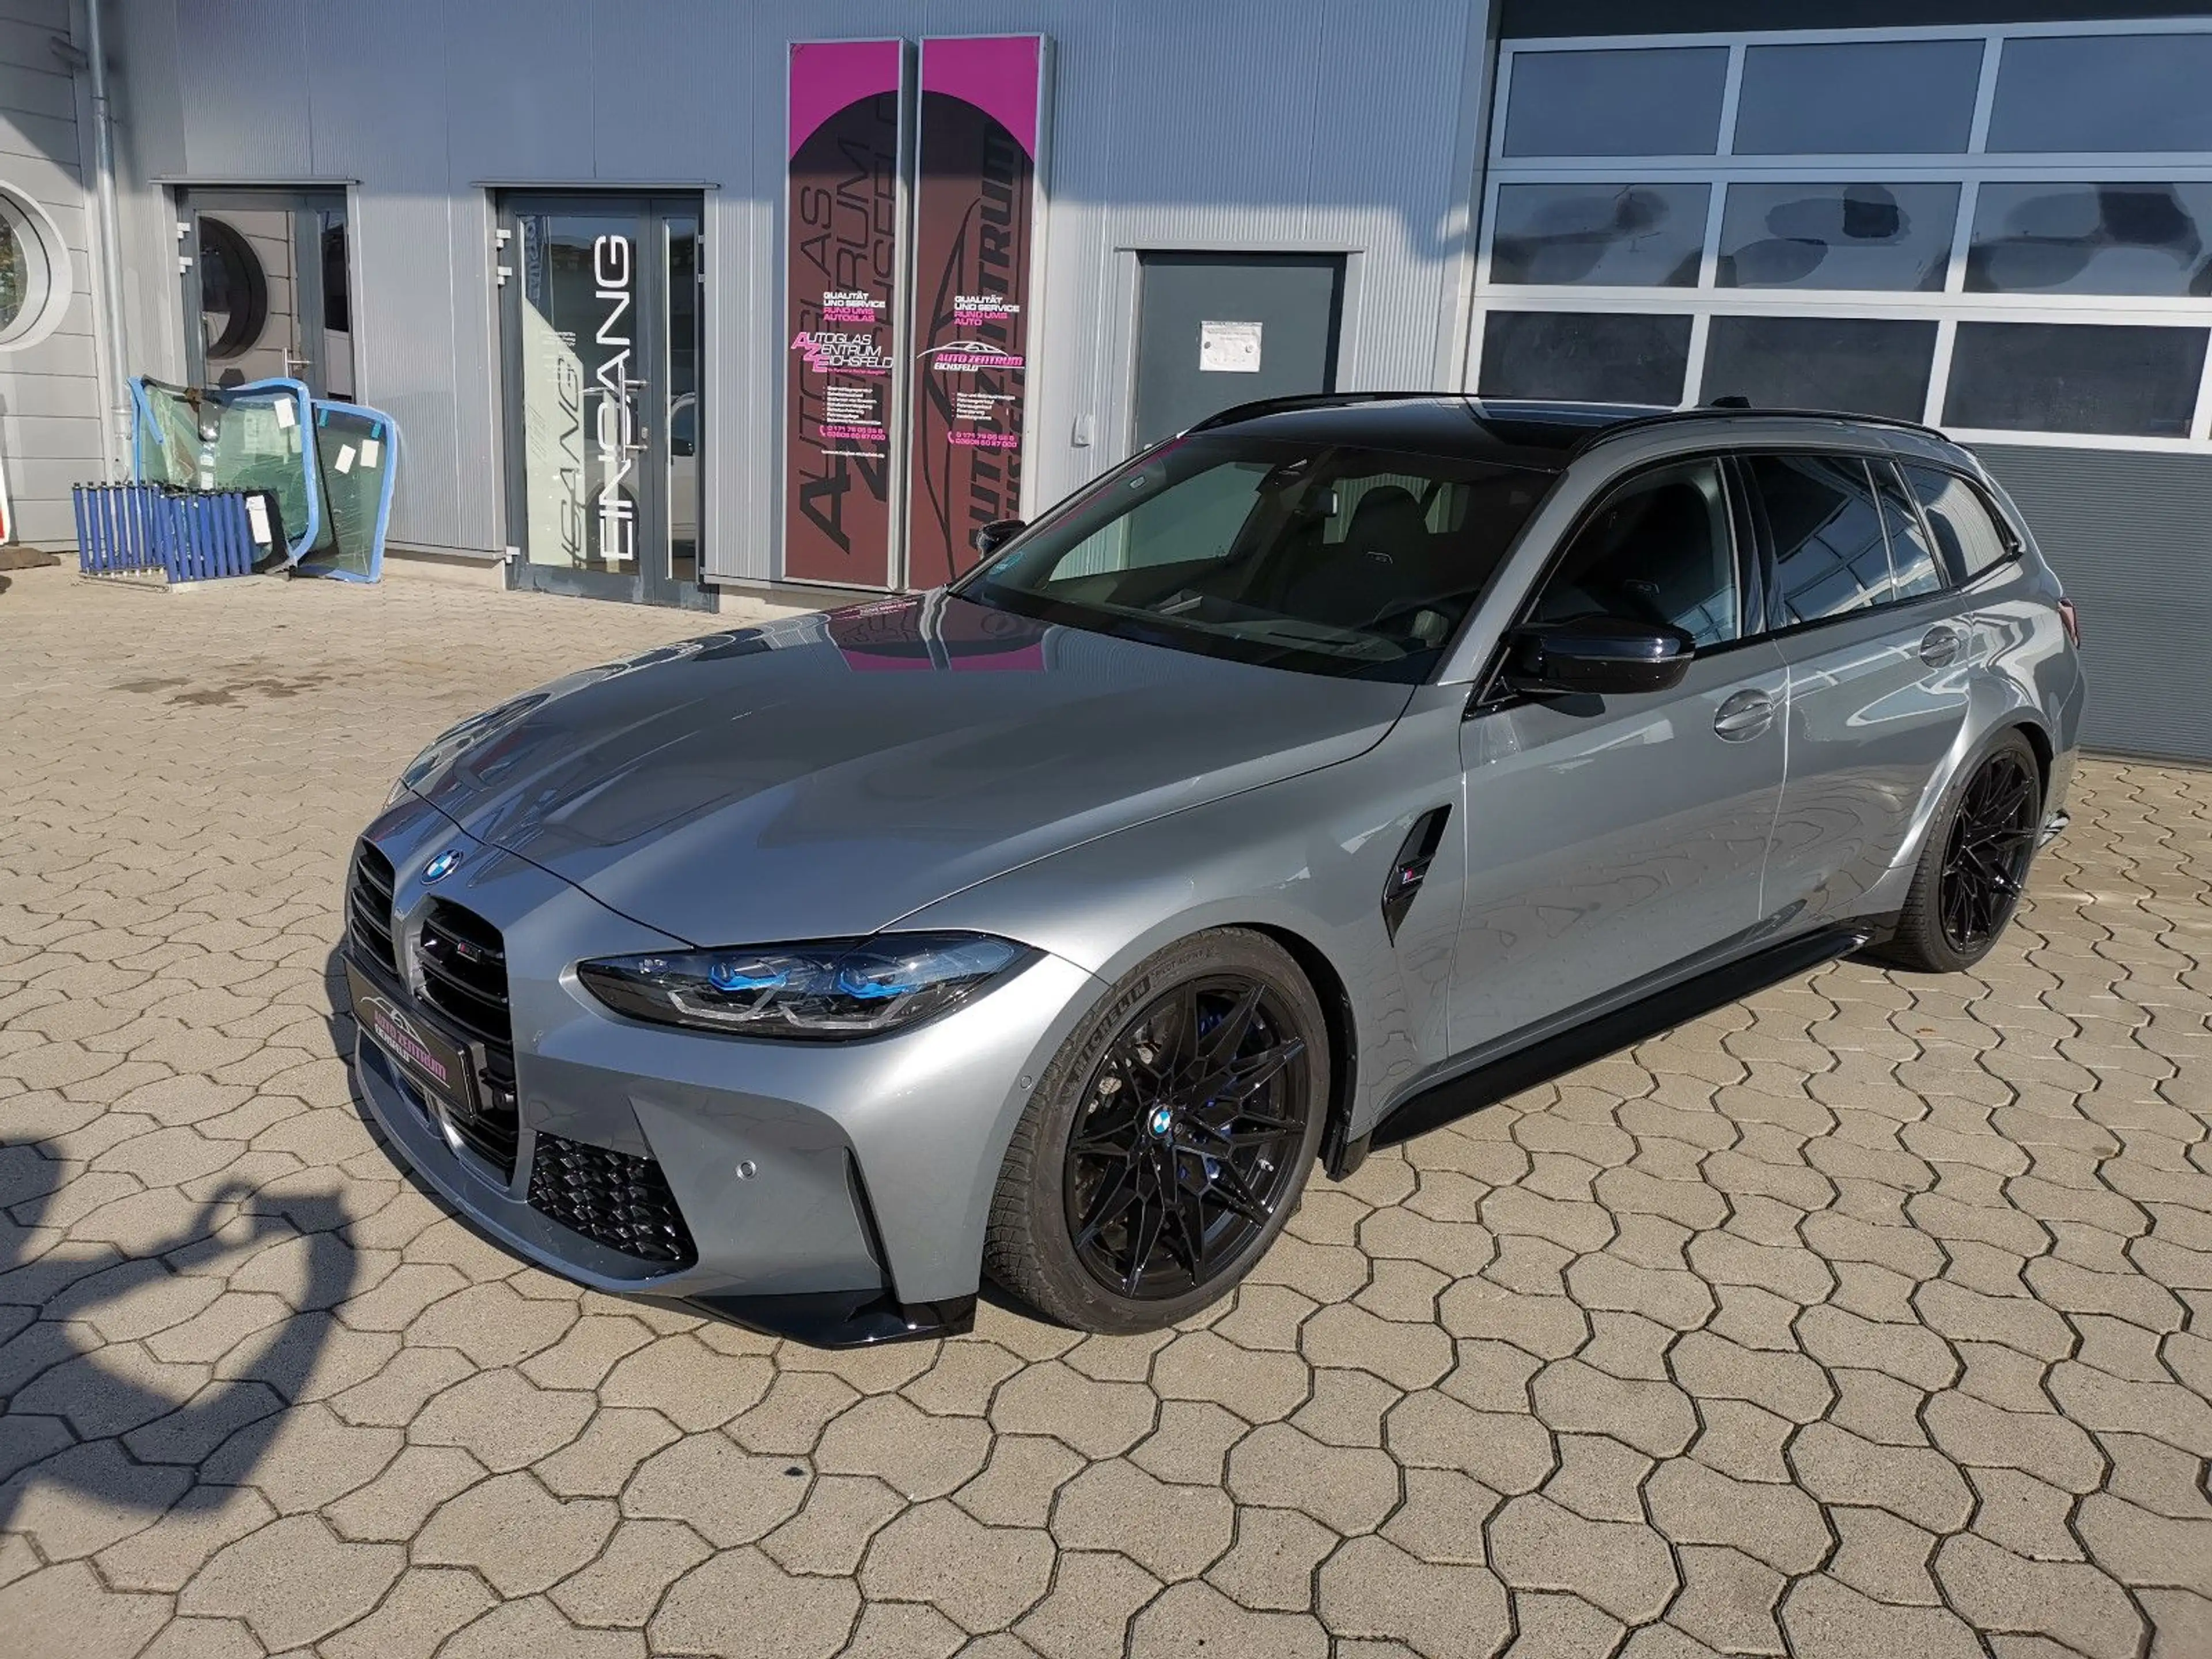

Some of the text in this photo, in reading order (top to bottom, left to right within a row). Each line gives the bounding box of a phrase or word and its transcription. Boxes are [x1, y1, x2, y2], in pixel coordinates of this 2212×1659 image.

[824, 290, 869, 300] QUALITÄT
[955, 294, 1003, 304] QUALITÄT
[978, 304, 1020, 312] SERVICE
[823, 314, 876, 322] AUTOGLAS
[954, 318, 982, 326] AUTO
[791, 332, 872, 349] AUTOGLAS
[804, 343, 881, 361] ZENTRUM
[812, 354, 893, 372] EICHSFELD
[936, 354, 1024, 365] AUTO ZENTRUM
[934, 362, 979, 372] EICHSFELD
